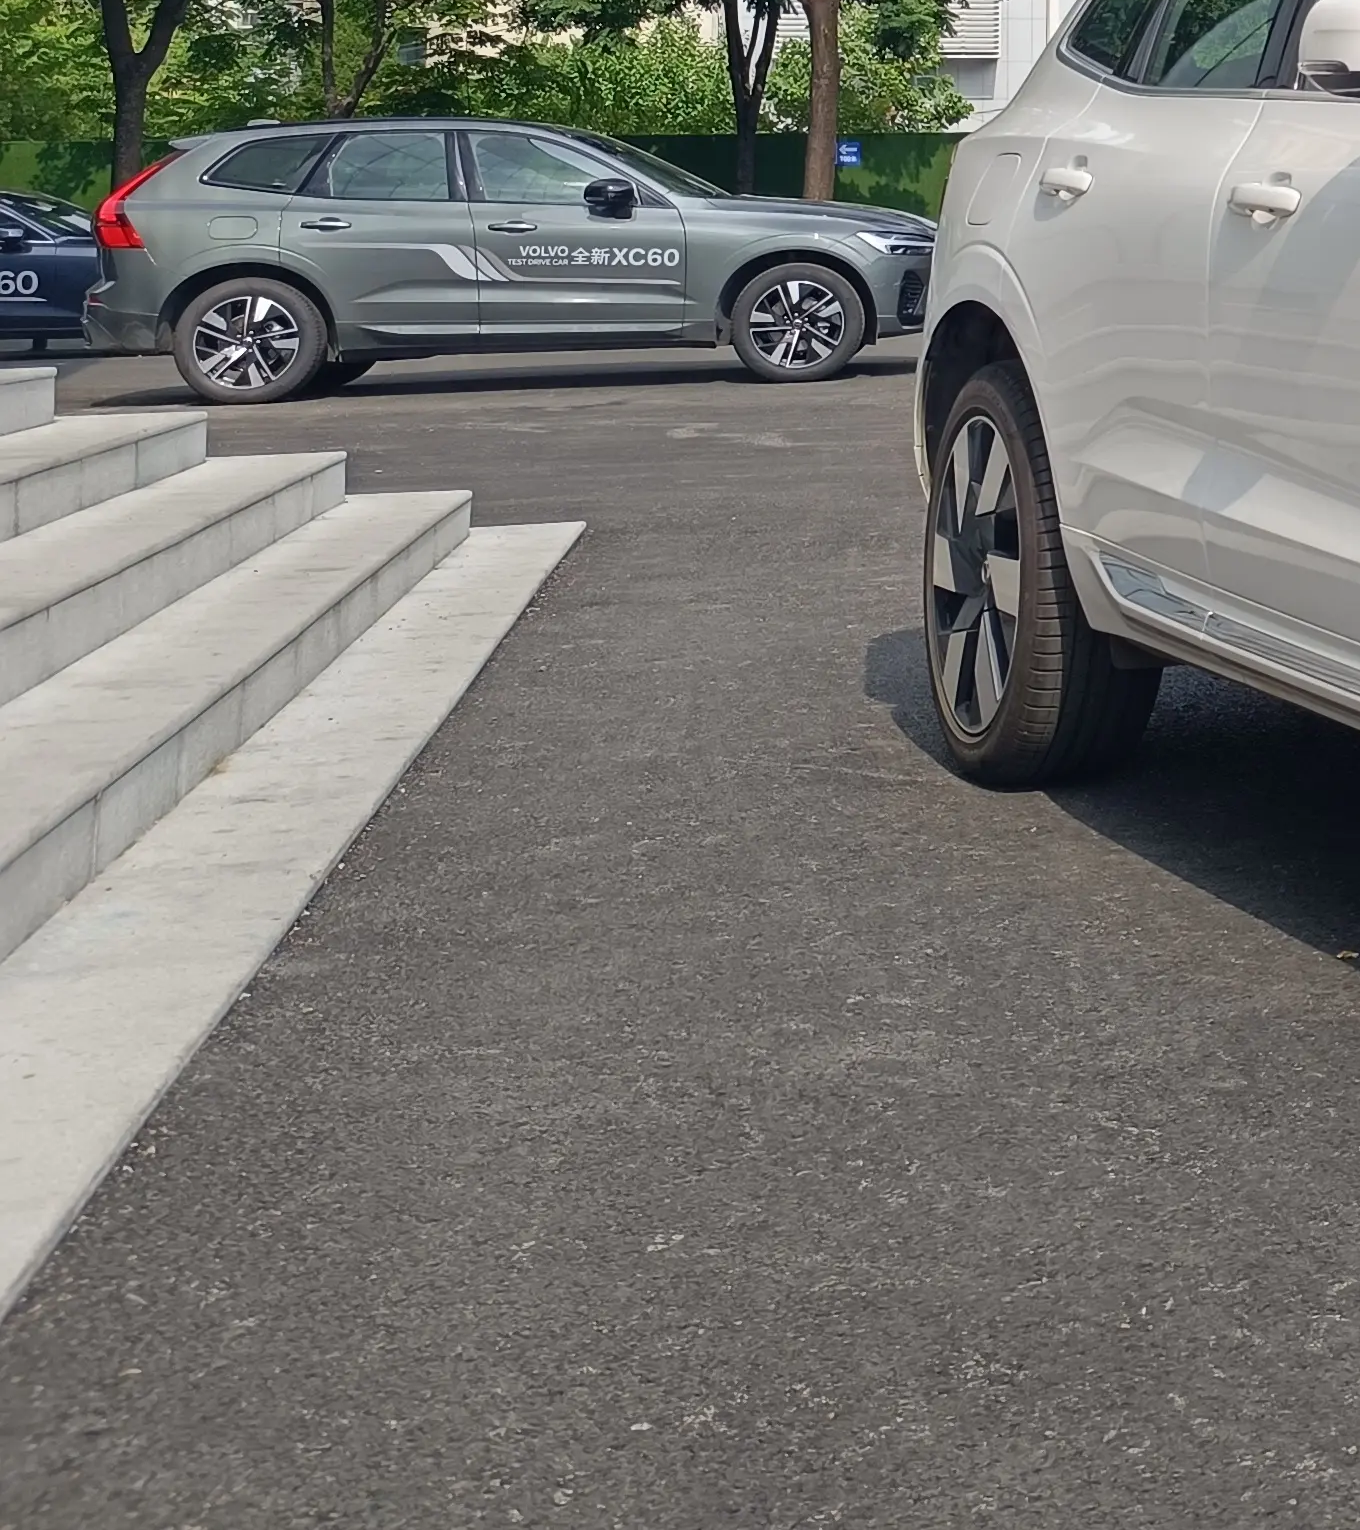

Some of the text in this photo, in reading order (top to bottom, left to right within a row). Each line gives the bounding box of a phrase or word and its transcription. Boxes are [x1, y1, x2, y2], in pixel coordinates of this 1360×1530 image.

[519, 245, 569, 257] VOLVO
[507, 258, 568, 266] TEST DRIVE CAR
